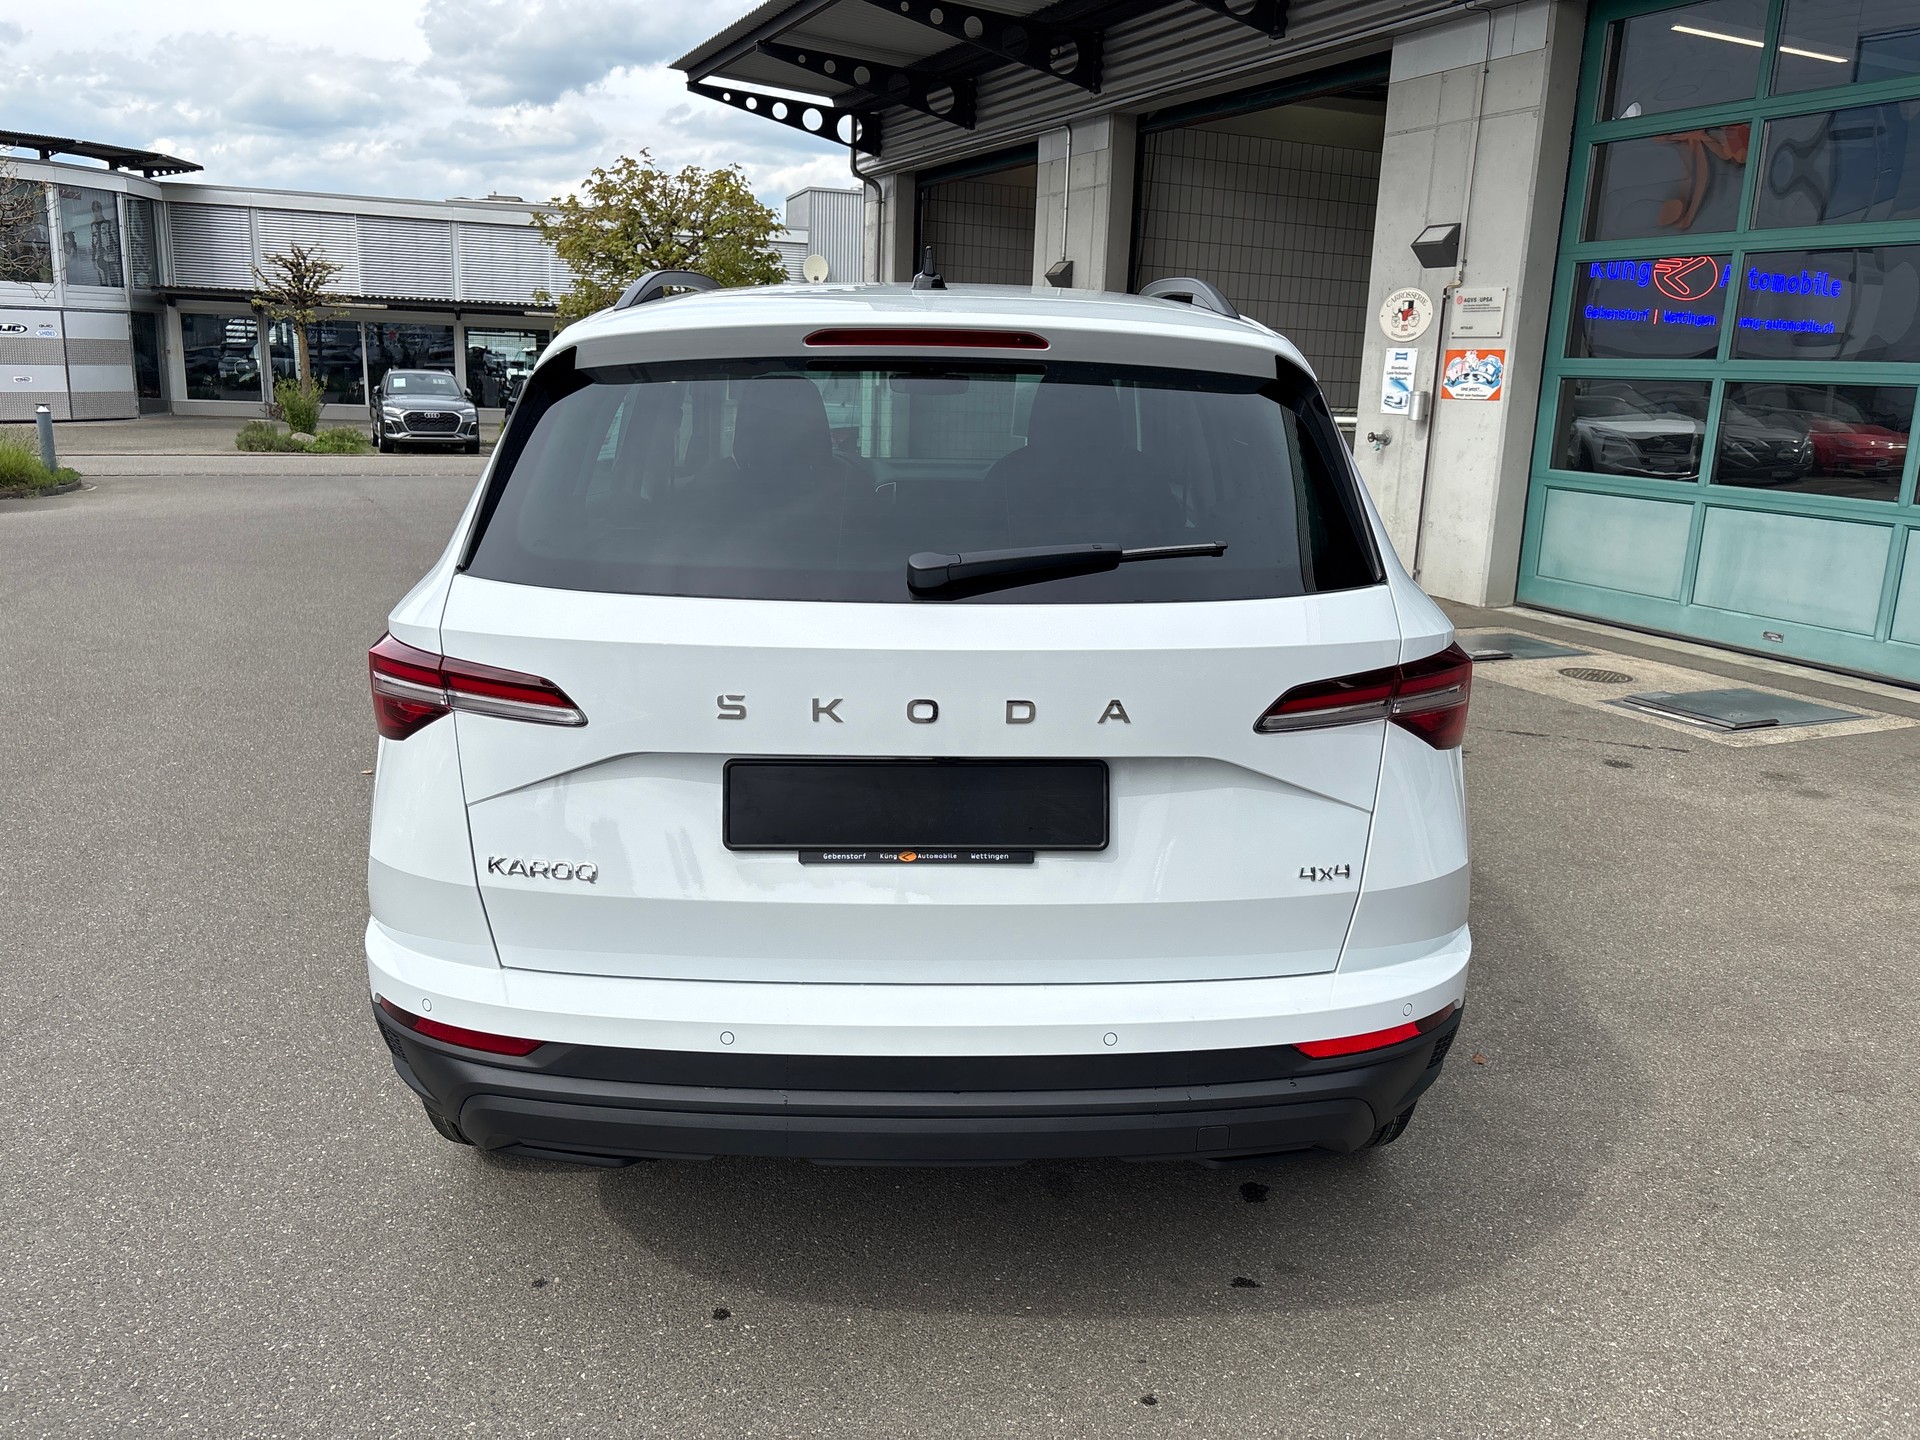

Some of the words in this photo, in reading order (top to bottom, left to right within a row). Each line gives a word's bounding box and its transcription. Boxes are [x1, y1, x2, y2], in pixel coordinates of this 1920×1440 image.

[1720, 264, 1842, 298] Atomobile
[1585, 305, 1650, 321] Gebenstorf
[1663, 310, 1716, 327] Wettingen
[717, 694, 1132, 725] SKODA
[971, 853, 1009, 861] Wettingen
[488, 856, 599, 884] KAROQ
[1299, 864, 1350, 882] 4x4
